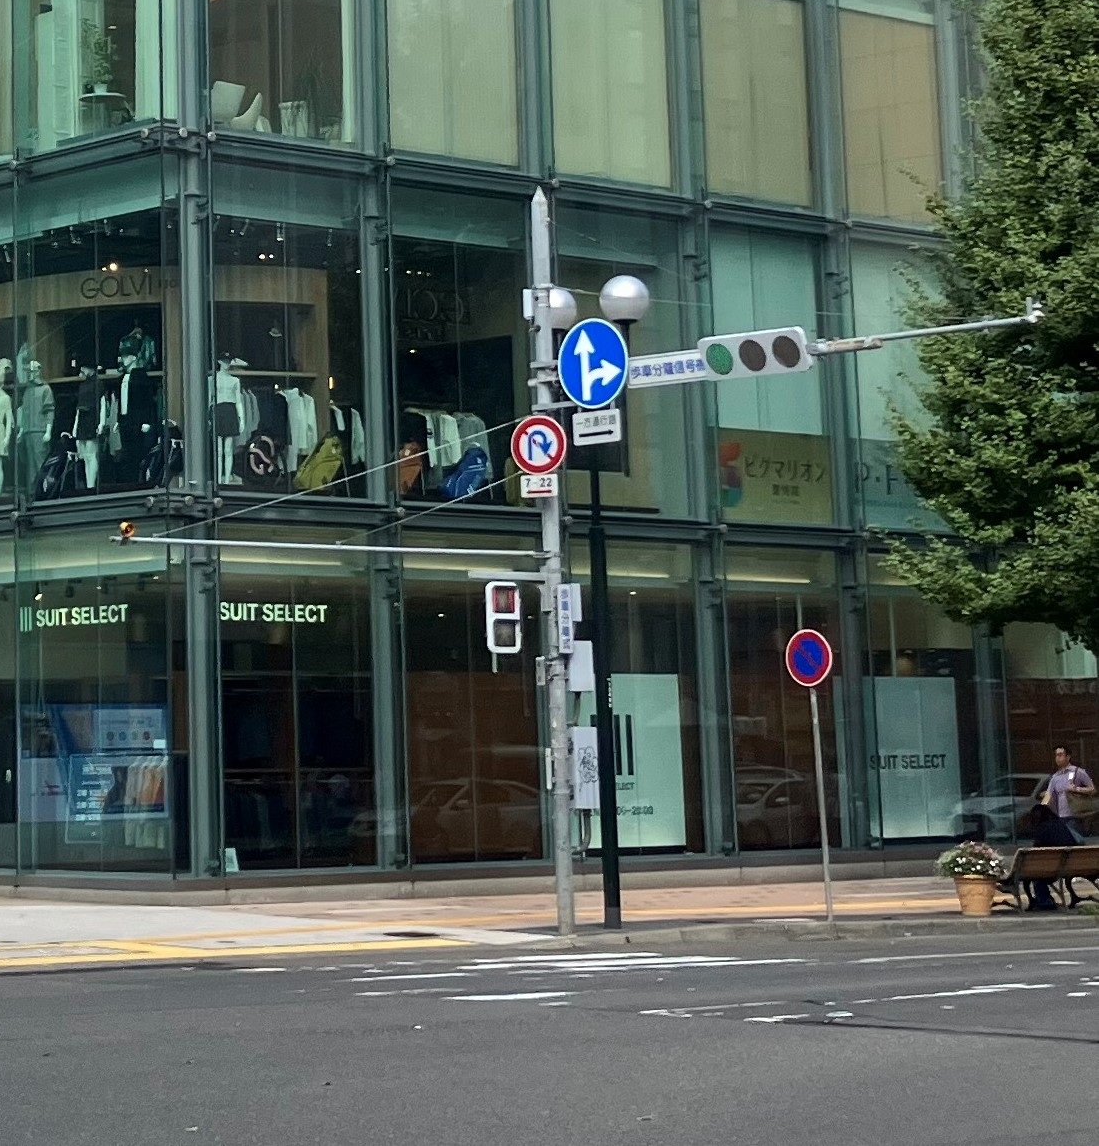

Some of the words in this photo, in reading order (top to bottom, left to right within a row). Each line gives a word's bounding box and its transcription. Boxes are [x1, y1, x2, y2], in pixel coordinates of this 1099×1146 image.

[80, 272, 152, 300] GOLVI
[36, 607, 68, 627] SUIT
[71, 604, 128, 626] SELECT
[219, 602, 259, 621] SUIT
[261, 603, 328, 623] SELECT
[869, 754, 898, 770] SUIT
[901, 754, 946, 770] SELECT
